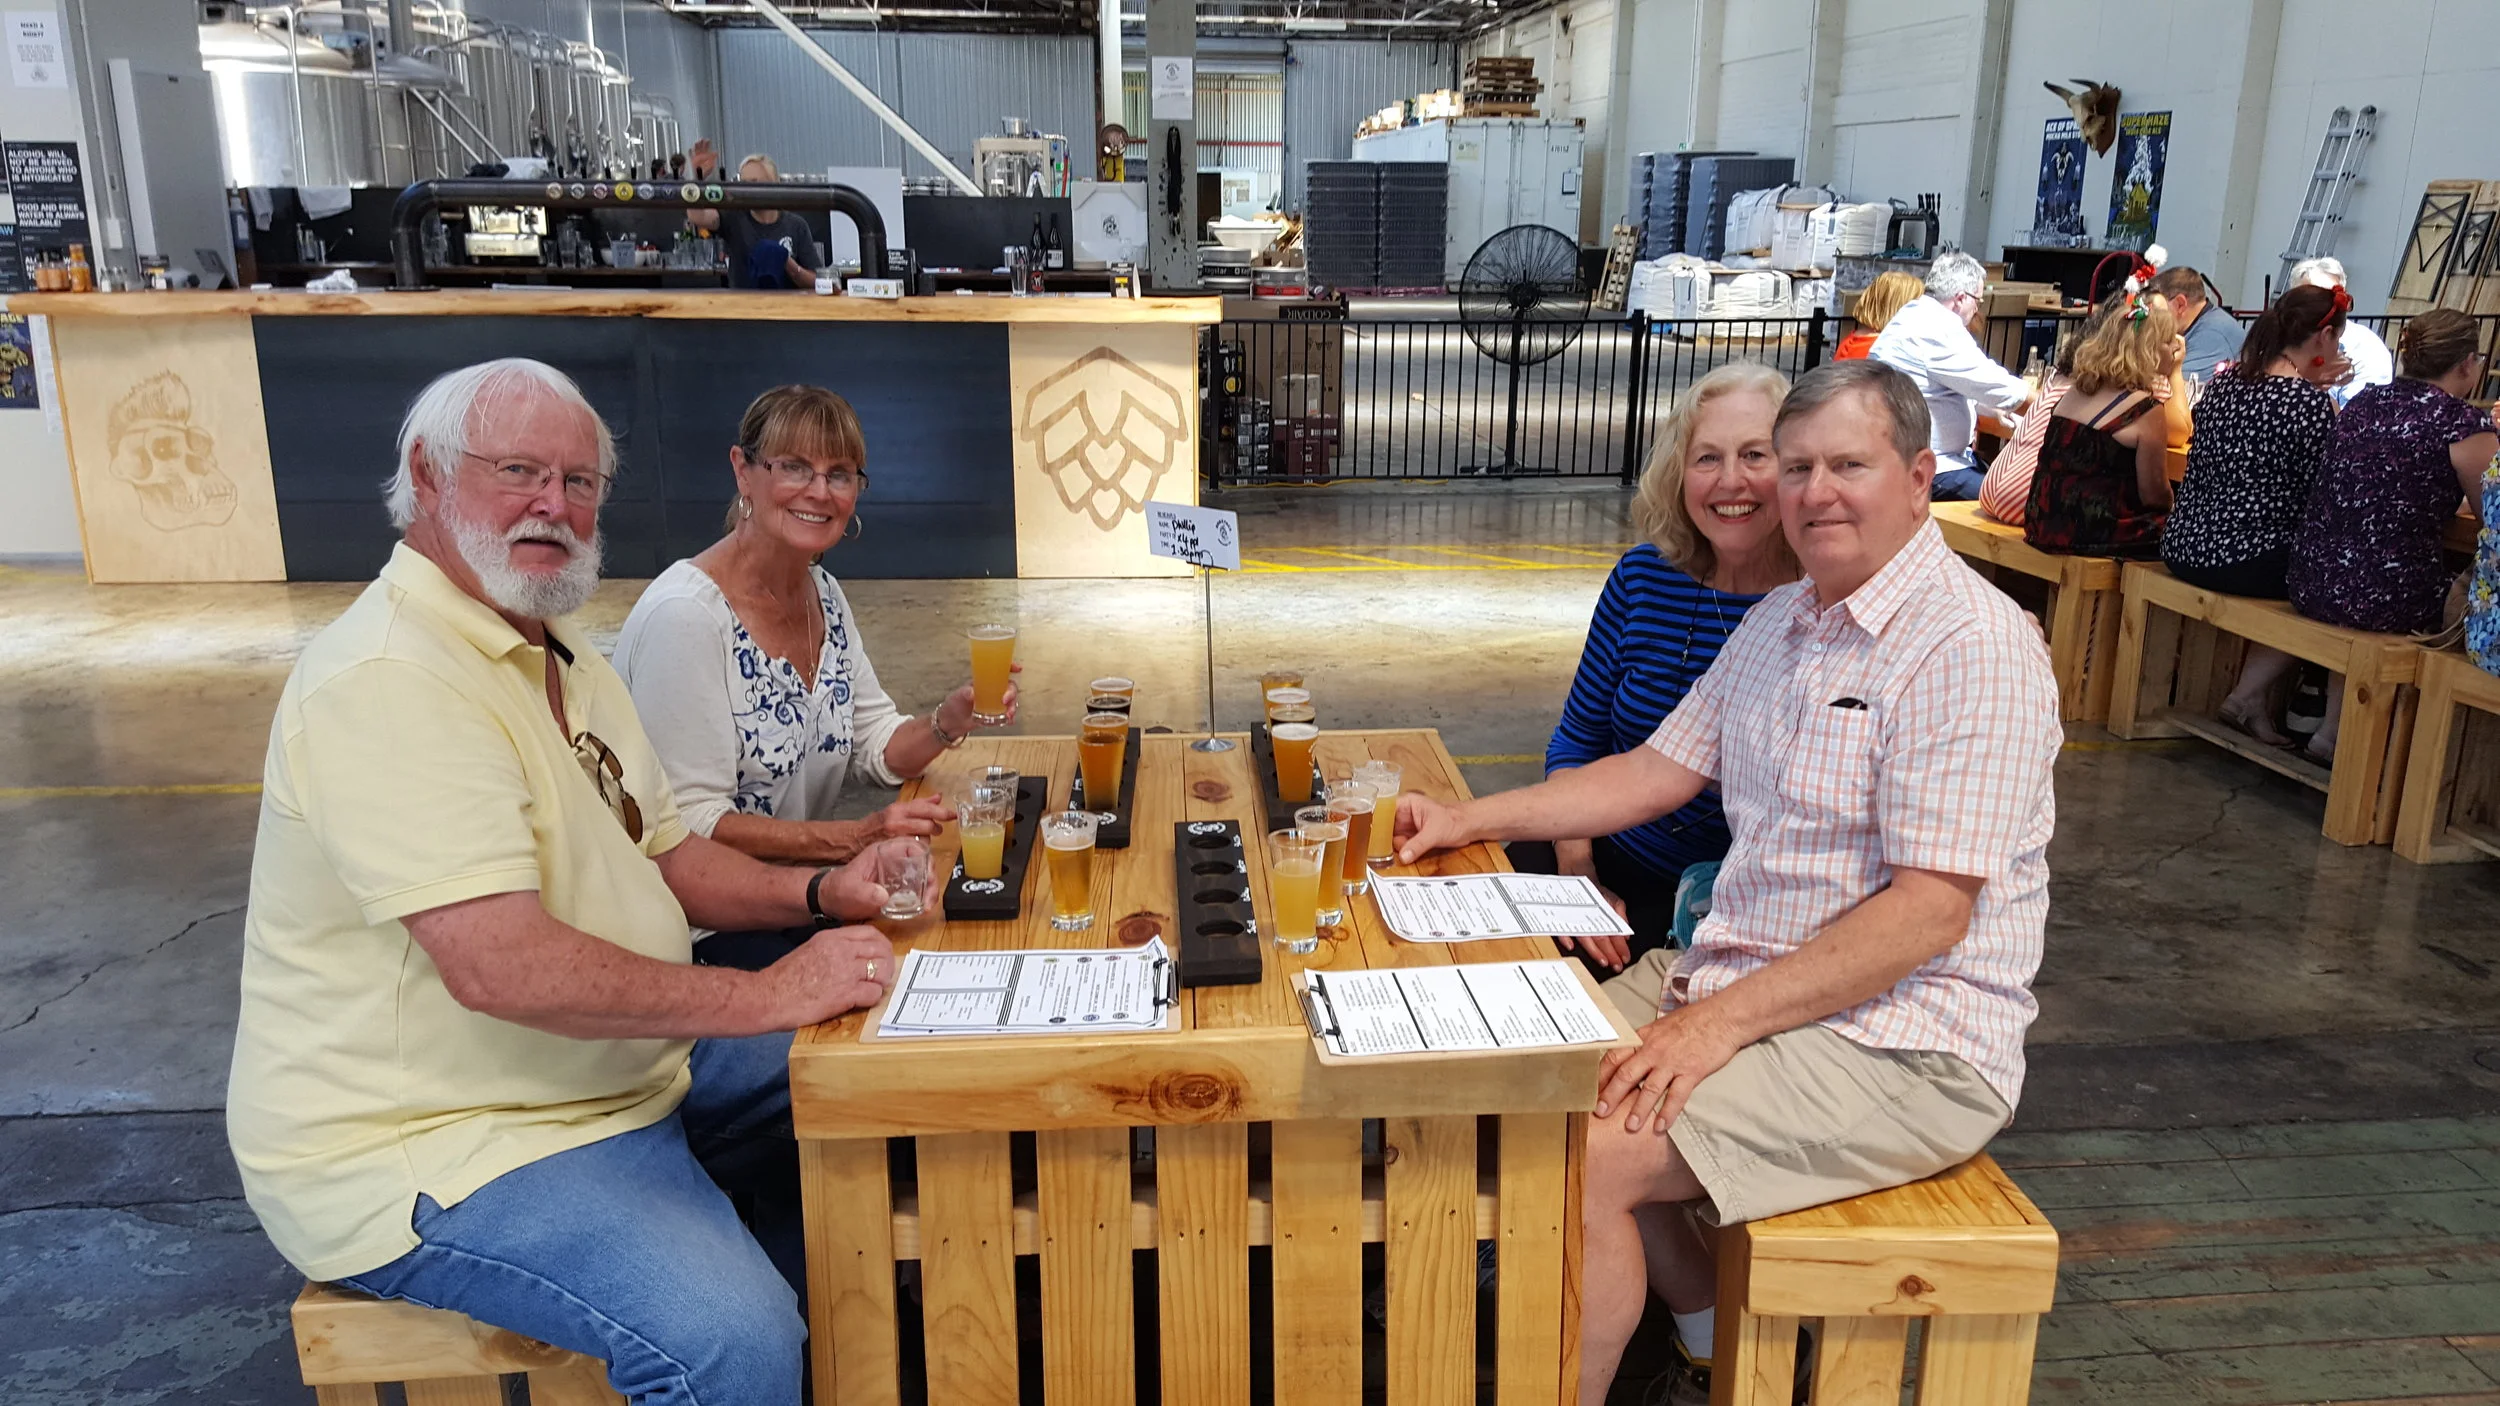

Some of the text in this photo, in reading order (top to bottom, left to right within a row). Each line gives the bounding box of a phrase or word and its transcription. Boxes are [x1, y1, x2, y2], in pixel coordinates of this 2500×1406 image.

[2121, 116, 2148, 127] SUPER
[2148, 114, 2169, 126] HAZE
[8, 150, 66, 159] ALCOHOL WILL
[9, 158, 73, 167] NOT BE SERVED
[11, 166, 78, 175] TO ANYONE WHO
[12, 174, 73, 183] IS INTOXICATED
[17, 203, 79, 212] FOOD AND FREE
[18, 211, 85, 220] WATER IS ALWAYS
[20, 219, 61, 227] AVAILABLE!
[1288, 308, 1331, 320] GOLDAIR
